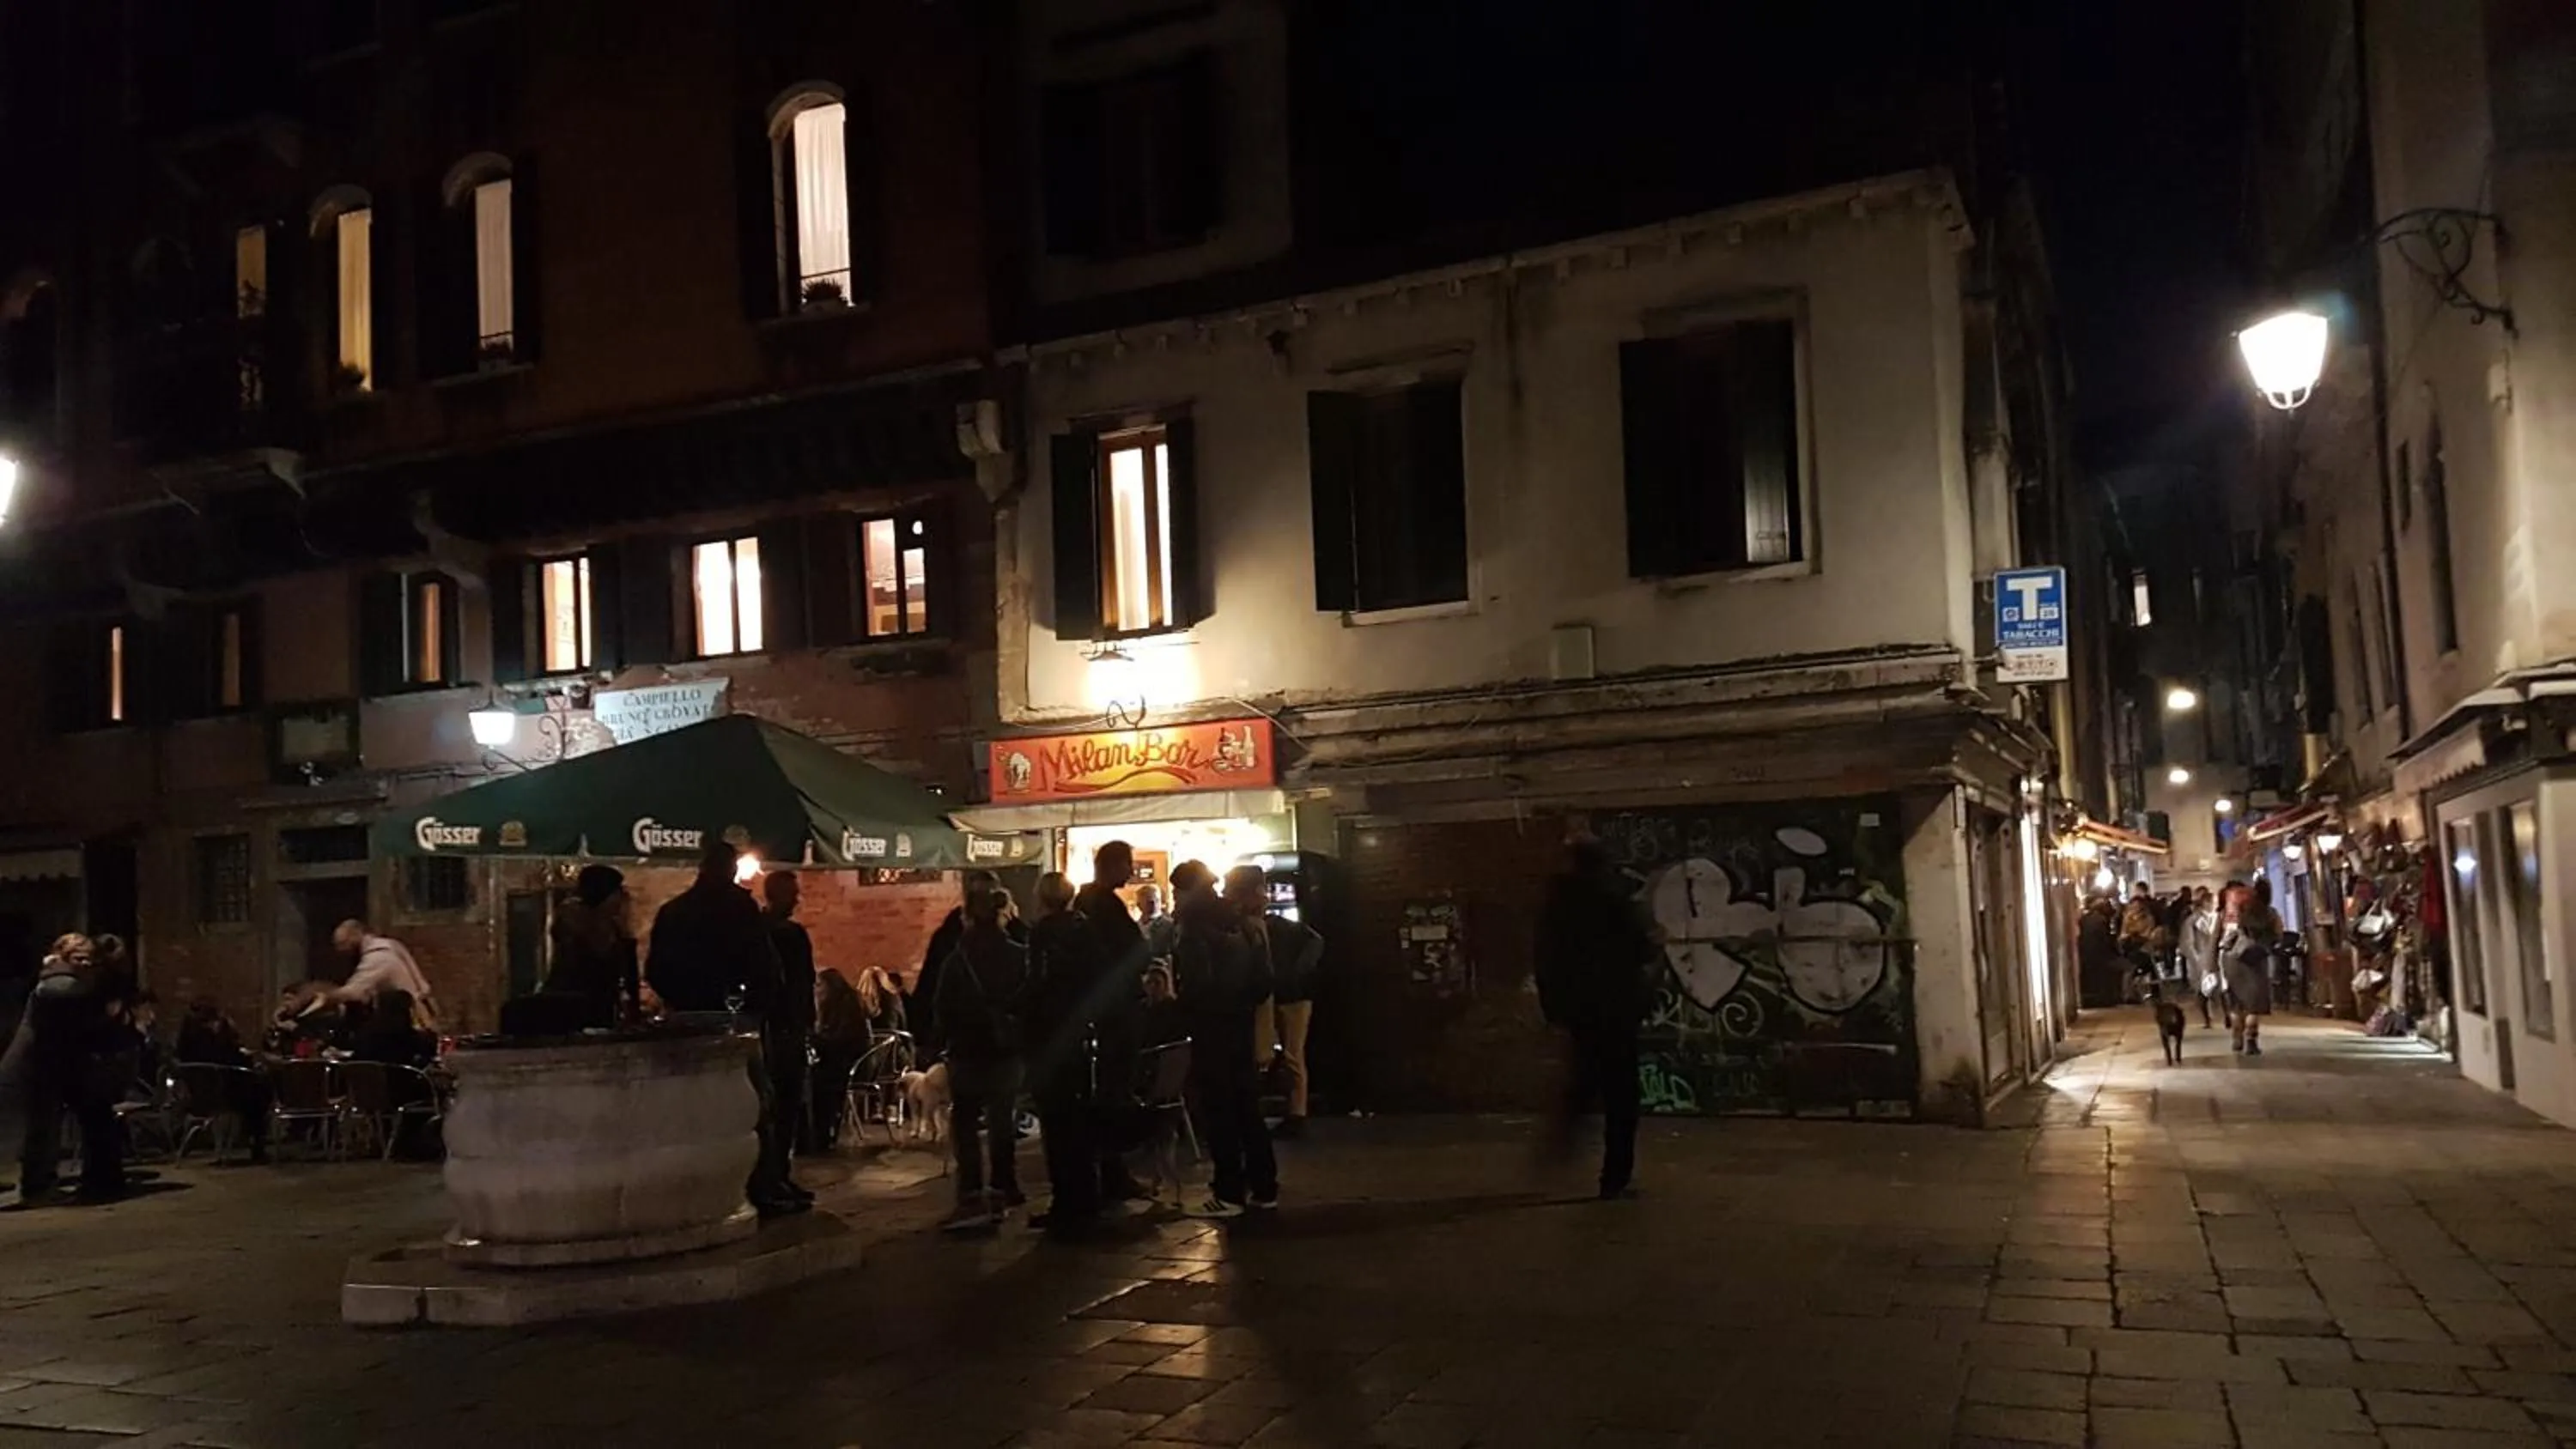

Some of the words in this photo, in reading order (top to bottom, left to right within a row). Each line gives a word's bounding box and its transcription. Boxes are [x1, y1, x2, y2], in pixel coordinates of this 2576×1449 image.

[2006, 576, 2053, 621] T
[623, 688, 702, 706] CAMPIELLO
[1039, 737, 1135, 792] Milan
[1135, 731, 1210, 768] Bar
[416, 816, 482, 851] Gösser
[632, 816, 704, 853] Gösser
[841, 827, 887, 861] Gösser
